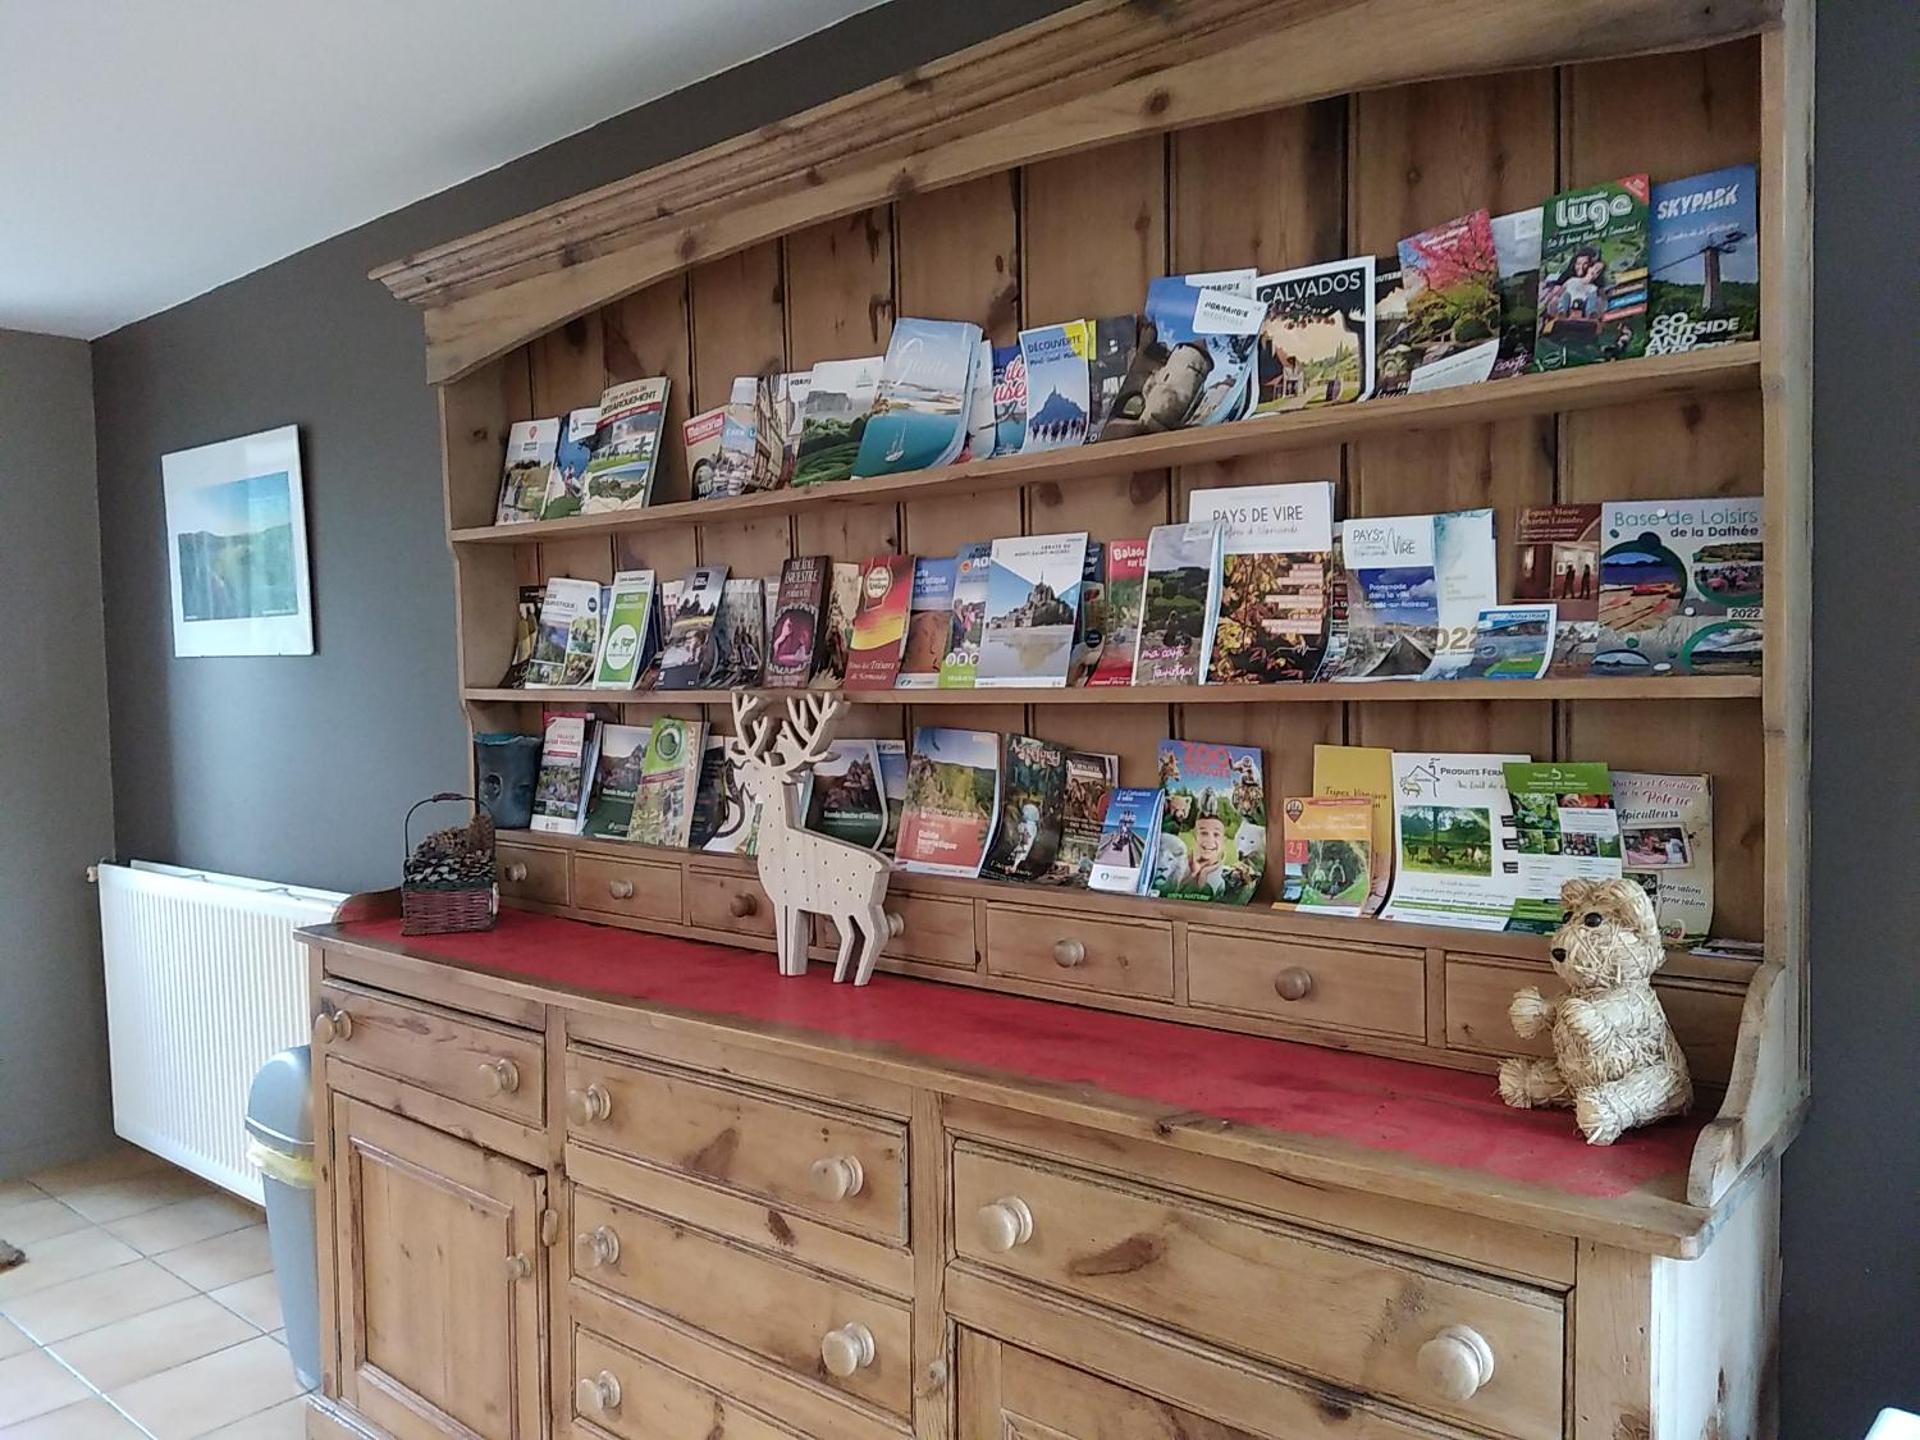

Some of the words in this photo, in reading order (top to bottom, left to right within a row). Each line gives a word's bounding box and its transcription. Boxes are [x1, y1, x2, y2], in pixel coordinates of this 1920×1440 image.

[1657, 184, 1740, 220] SKYPARK
[1555, 194, 1633, 231] luge
[1260, 271, 1361, 304] CALVADOS
[1650, 317, 1740, 337] OUTSIDE
[1652, 312, 1688, 327] GO
[1651, 333, 1698, 348] AND
[1213, 508, 1247, 523] PAYS
[1252, 507, 1269, 522] DE
[1273, 505, 1304, 520] VIRE
[1614, 511, 1660, 527] Base
[1666, 510, 1694, 526] de
[1701, 506, 1759, 525] Loisirs
[1353, 529, 1380, 541] PAYS
[1670, 527, 1688, 537] de
[1692, 527, 1704, 537] la
[1708, 525, 1760, 537] Dathée
[1731, 608, 1761, 618] 2022
[1440, 767, 1480, 776] PRODUITS
[1617, 809, 1679, 822] Apiculteurs
